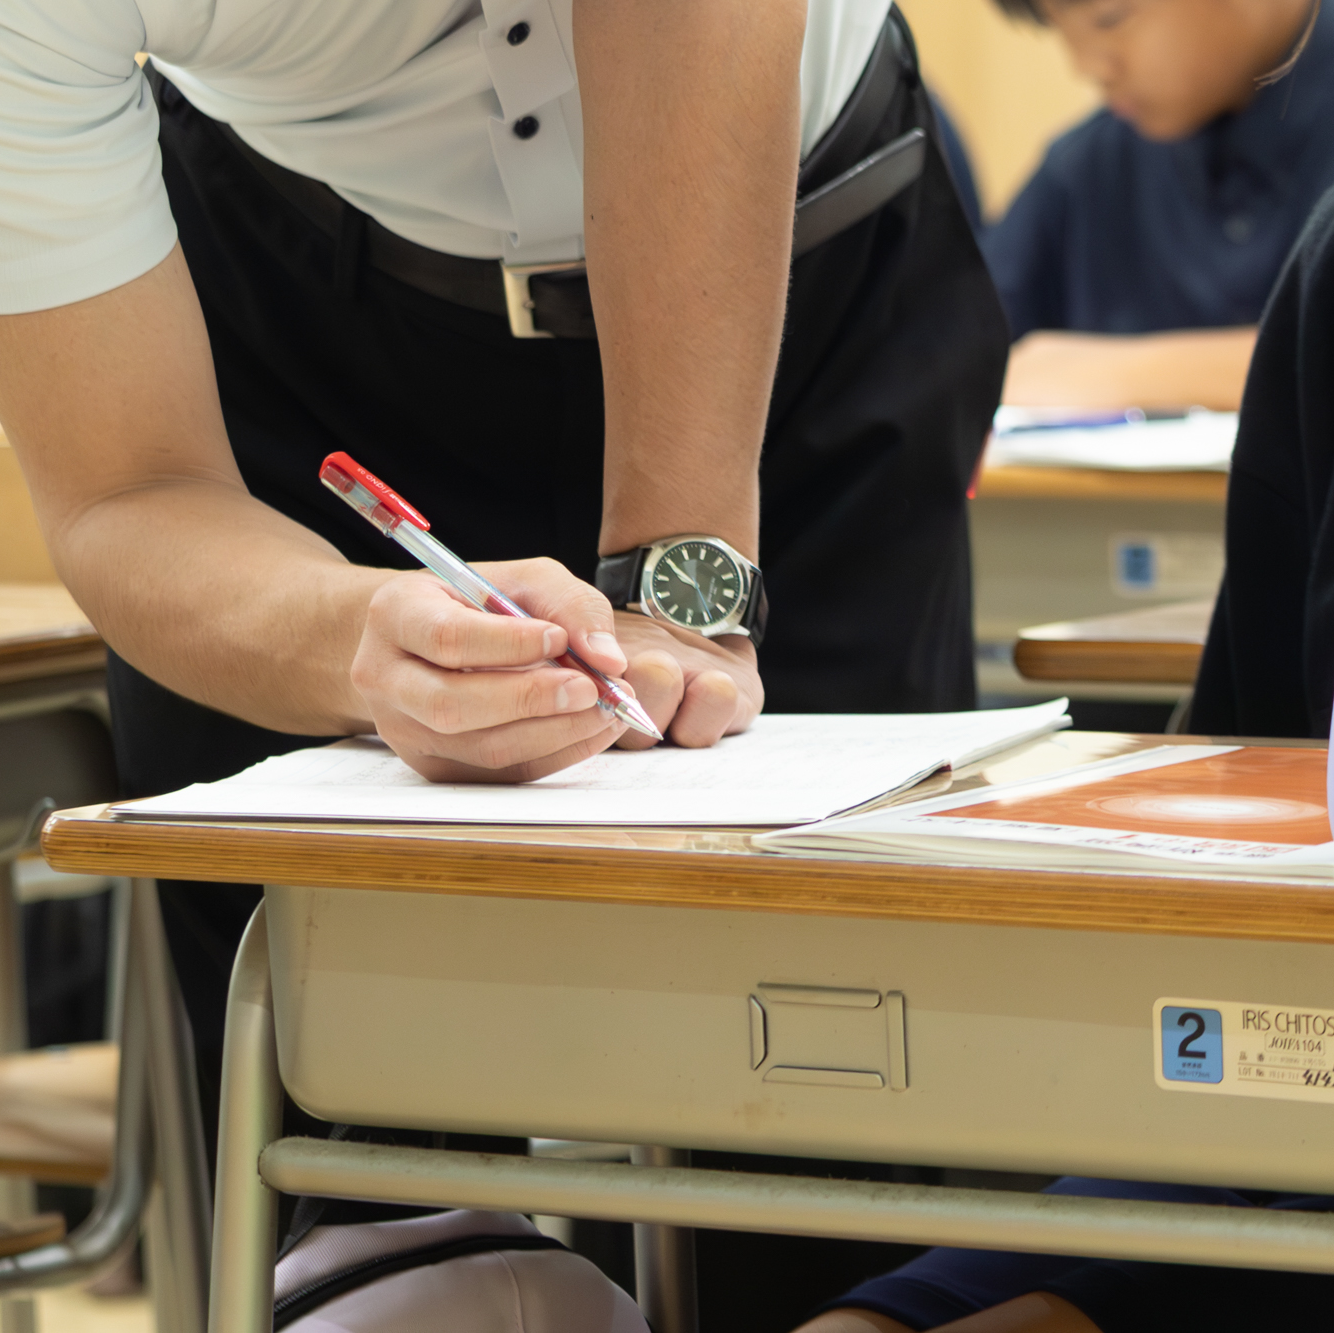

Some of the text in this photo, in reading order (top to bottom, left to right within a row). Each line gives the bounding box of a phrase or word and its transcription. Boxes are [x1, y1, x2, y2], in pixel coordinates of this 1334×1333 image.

[1241, 1009, 1271, 1032] IRIS
[1177, 1012, 1207, 1059] 2
[1303, 1039, 1322, 1053] 104
